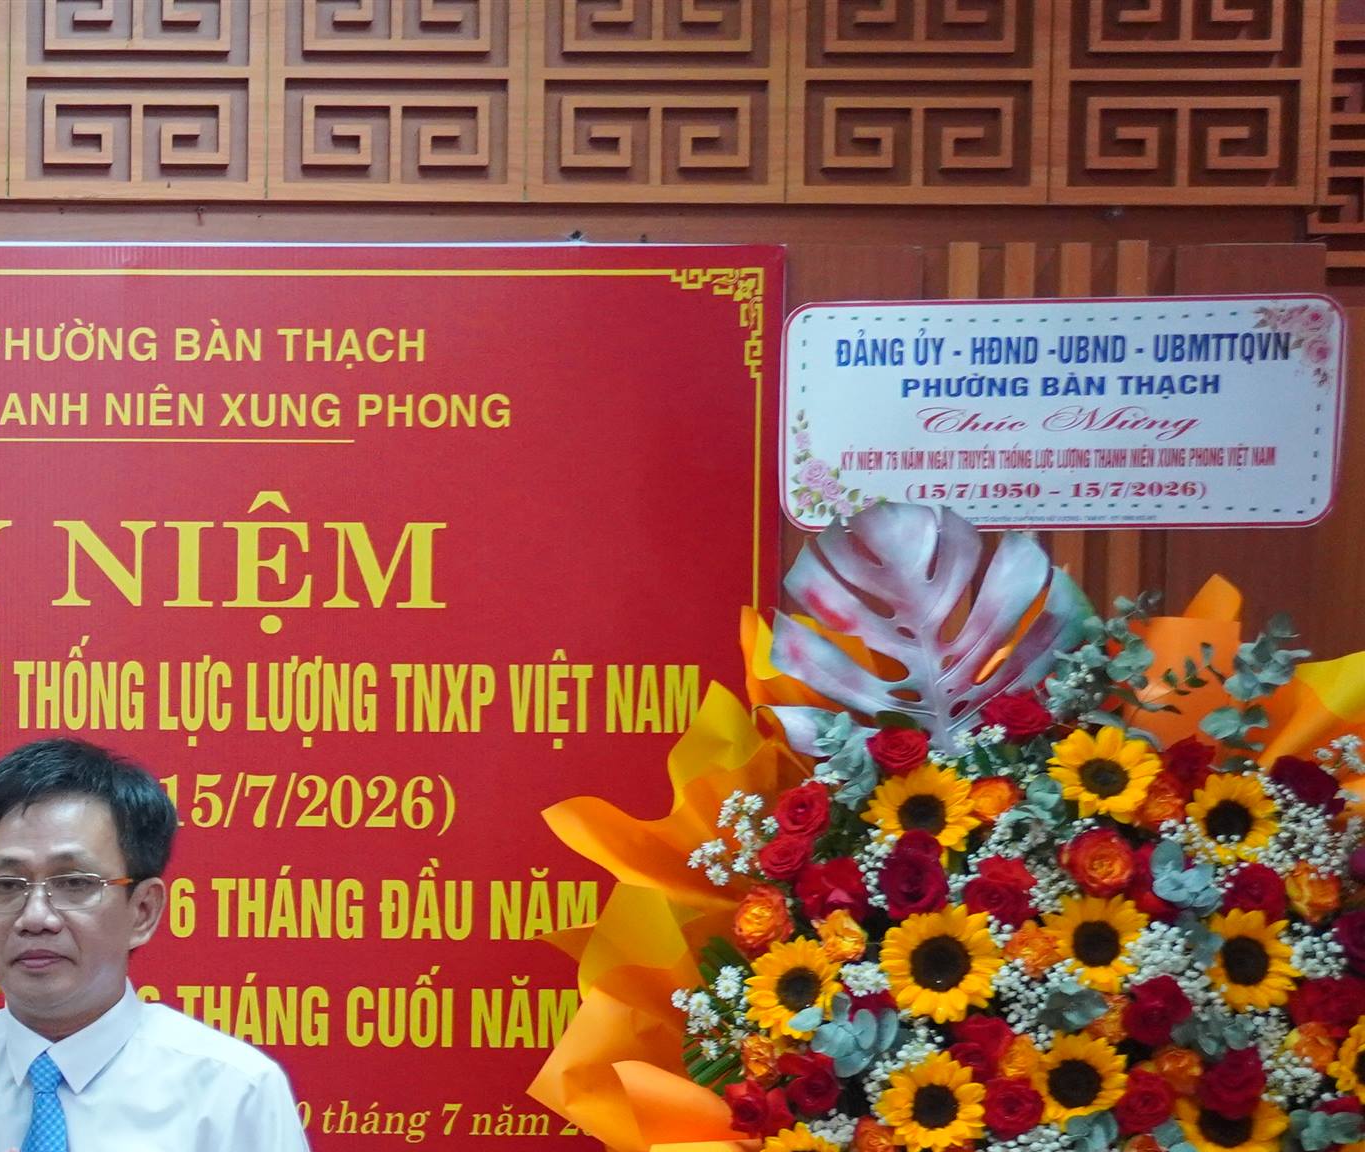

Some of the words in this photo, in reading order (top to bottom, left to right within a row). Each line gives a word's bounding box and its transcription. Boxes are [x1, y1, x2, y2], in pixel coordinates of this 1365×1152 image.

[176, 320, 261, 360] BÀN
[277, 328, 425, 368] THẠCH
[836, 329, 904, 366] ĐẢNG
[914, 328, 945, 365] ỦY
[971, 336, 1038, 364] HĐND
[1153, 331, 1290, 364] UBMTTQVN
[105, 384, 203, 426] NIÊN
[221, 393, 340, 427] XUNG
[358, 394, 510, 428] PHONG
[902, 373, 1028, 397] PHƯỜNG
[1041, 372, 1105, 396] BÀN
[1118, 375, 1220, 399] THẠCH
[916, 405, 1028, 433] Chúc
[1041, 404, 1203, 441] Mừng
[841, 446, 853, 471] KỶ
[857, 448, 882, 475] NIỆM
[886, 451, 898, 470] 76
[900, 448, 924, 470] NĂM
[927, 445, 953, 470] NGÀY
[958, 446, 995, 470] TRUYỀN
[999, 445, 1031, 469] THỐNG
[1035, 448, 1054, 473] LỰC
[1057, 448, 1090, 473] LƯỢNG
[1094, 448, 1126, 468] THANH
[1130, 444, 1156, 468] NIÊN
[1159, 448, 1185, 468] XUNG
[1189, 447, 1224, 467] PHONG
[1227, 443, 1249, 471] VIỆT
[1252, 447, 1276, 467] NAM
[906, 482, 1040, 502] (15/7/1950
[1070, 481, 1207, 501] 15/7/2026)
[53, 491, 446, 634] NIỆM
[14, 636, 144, 730] THỐNG
[159, 655, 232, 746] LỰC
[247, 656, 377, 747] LƯỢNG
[391, 664, 495, 732] TNXP
[509, 649, 593, 749] VIỆT
[606, 664, 700, 733] NAM
[170, 878, 195, 937] 6
[212, 865, 363, 939] THÁNG
[380, 858, 472, 940] ĐẦU
[489, 867, 598, 940] NĂM
[177, 973, 329, 1046] THÁNG
[347, 966, 453, 1047] CUỐI
[471, 976, 579, 1049] NĂM
[323, 1101, 430, 1142] tháng
[443, 1104, 461, 1135] 7
[469, 1104, 550, 1136] năm
